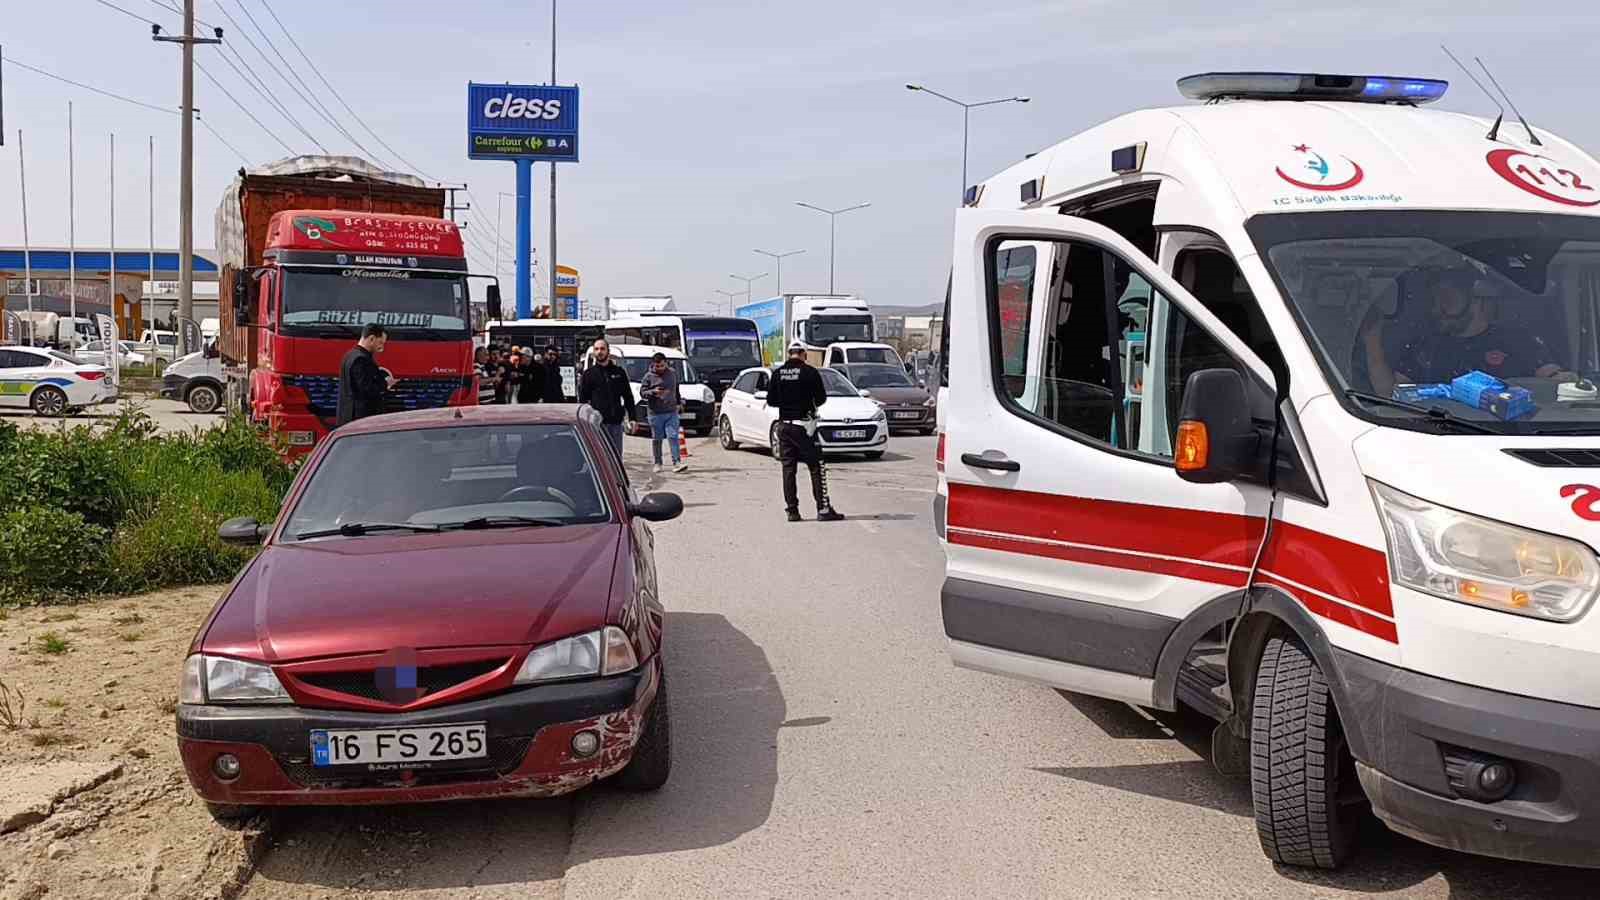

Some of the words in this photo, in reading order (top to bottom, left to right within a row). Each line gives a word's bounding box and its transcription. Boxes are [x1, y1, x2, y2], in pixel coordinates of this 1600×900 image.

[484, 93, 561, 120] class
[475, 135, 522, 147] Carrefour
[1516, 164, 1595, 192] 112
[1294, 194, 1337, 205] Sağlık
[355, 255, 375, 264] ALLAH
[330, 734, 361, 761] 16
[375, 733, 419, 758] FS
[429, 728, 483, 756] 265
